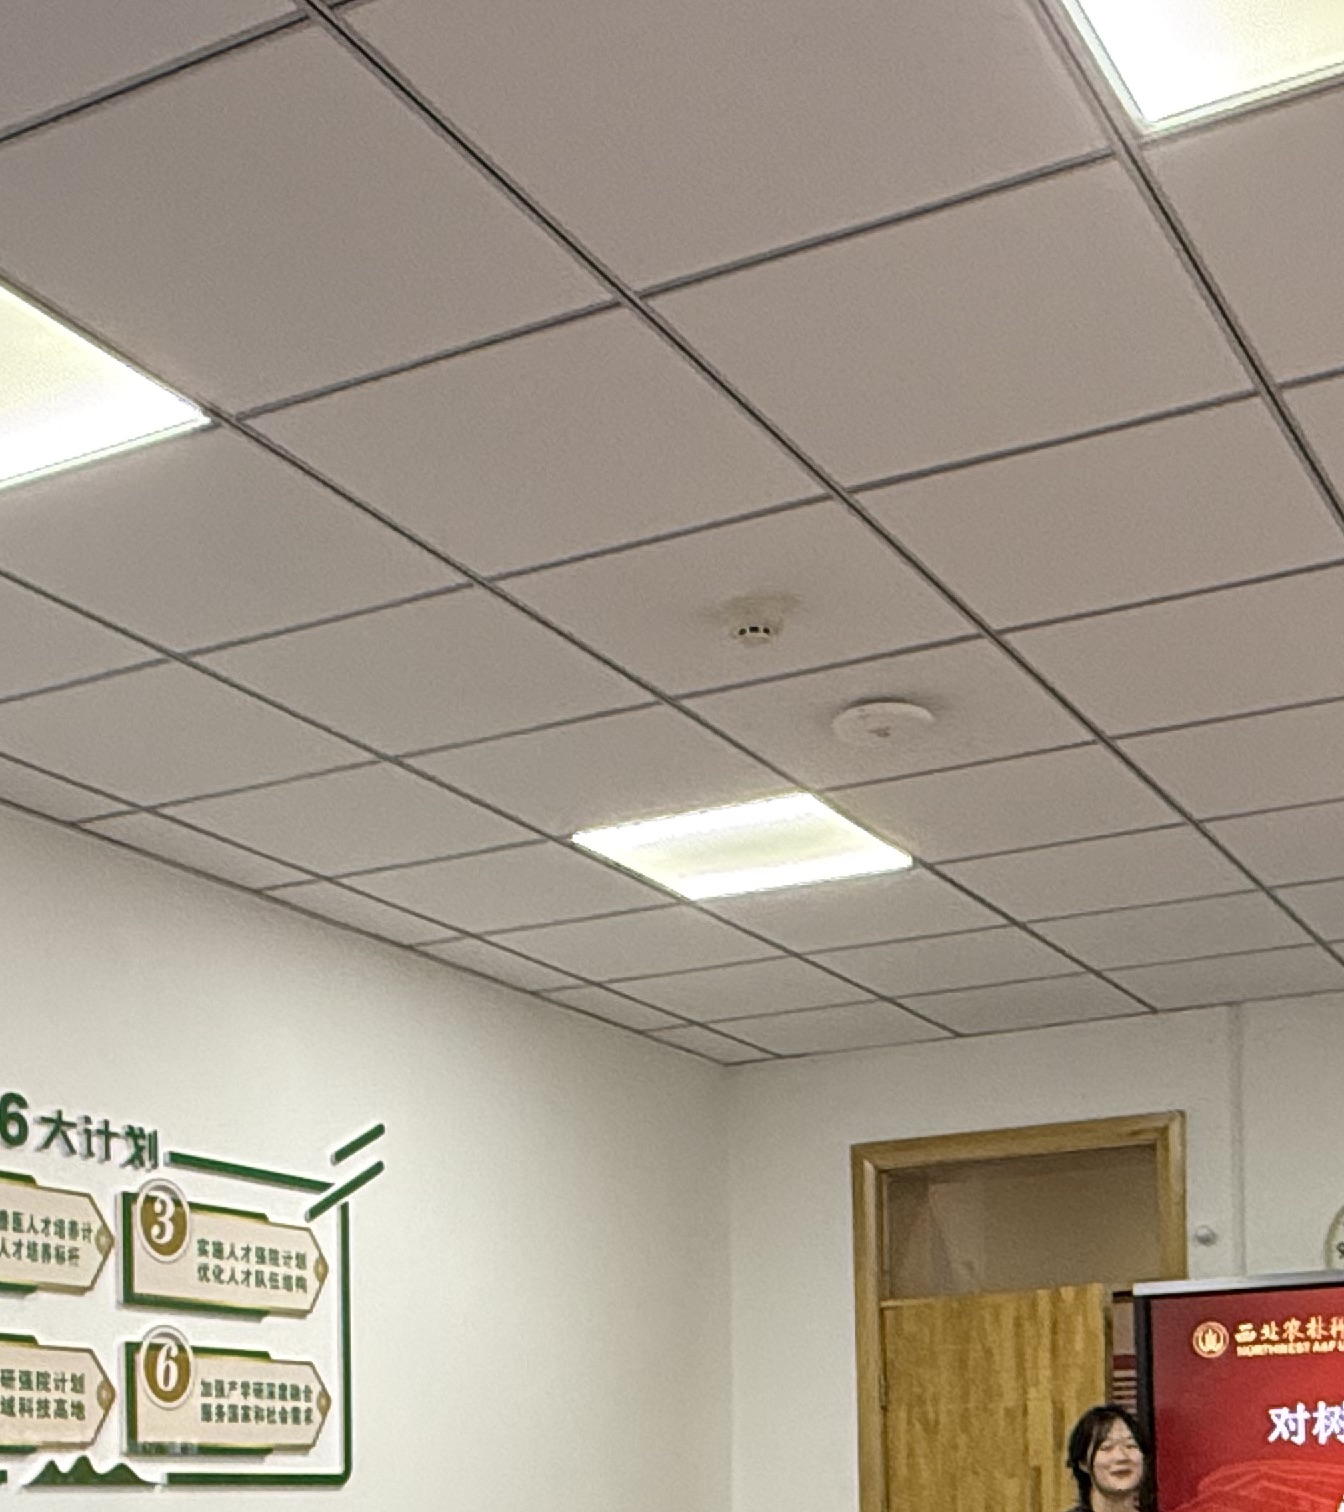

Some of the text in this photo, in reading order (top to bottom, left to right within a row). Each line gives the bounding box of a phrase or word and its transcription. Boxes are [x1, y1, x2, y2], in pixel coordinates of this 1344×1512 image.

[151, 1194, 174, 1245] 3
[197, 1238, 308, 1271] 实施人才强院计划
[156, 1343, 179, 1392] 6
